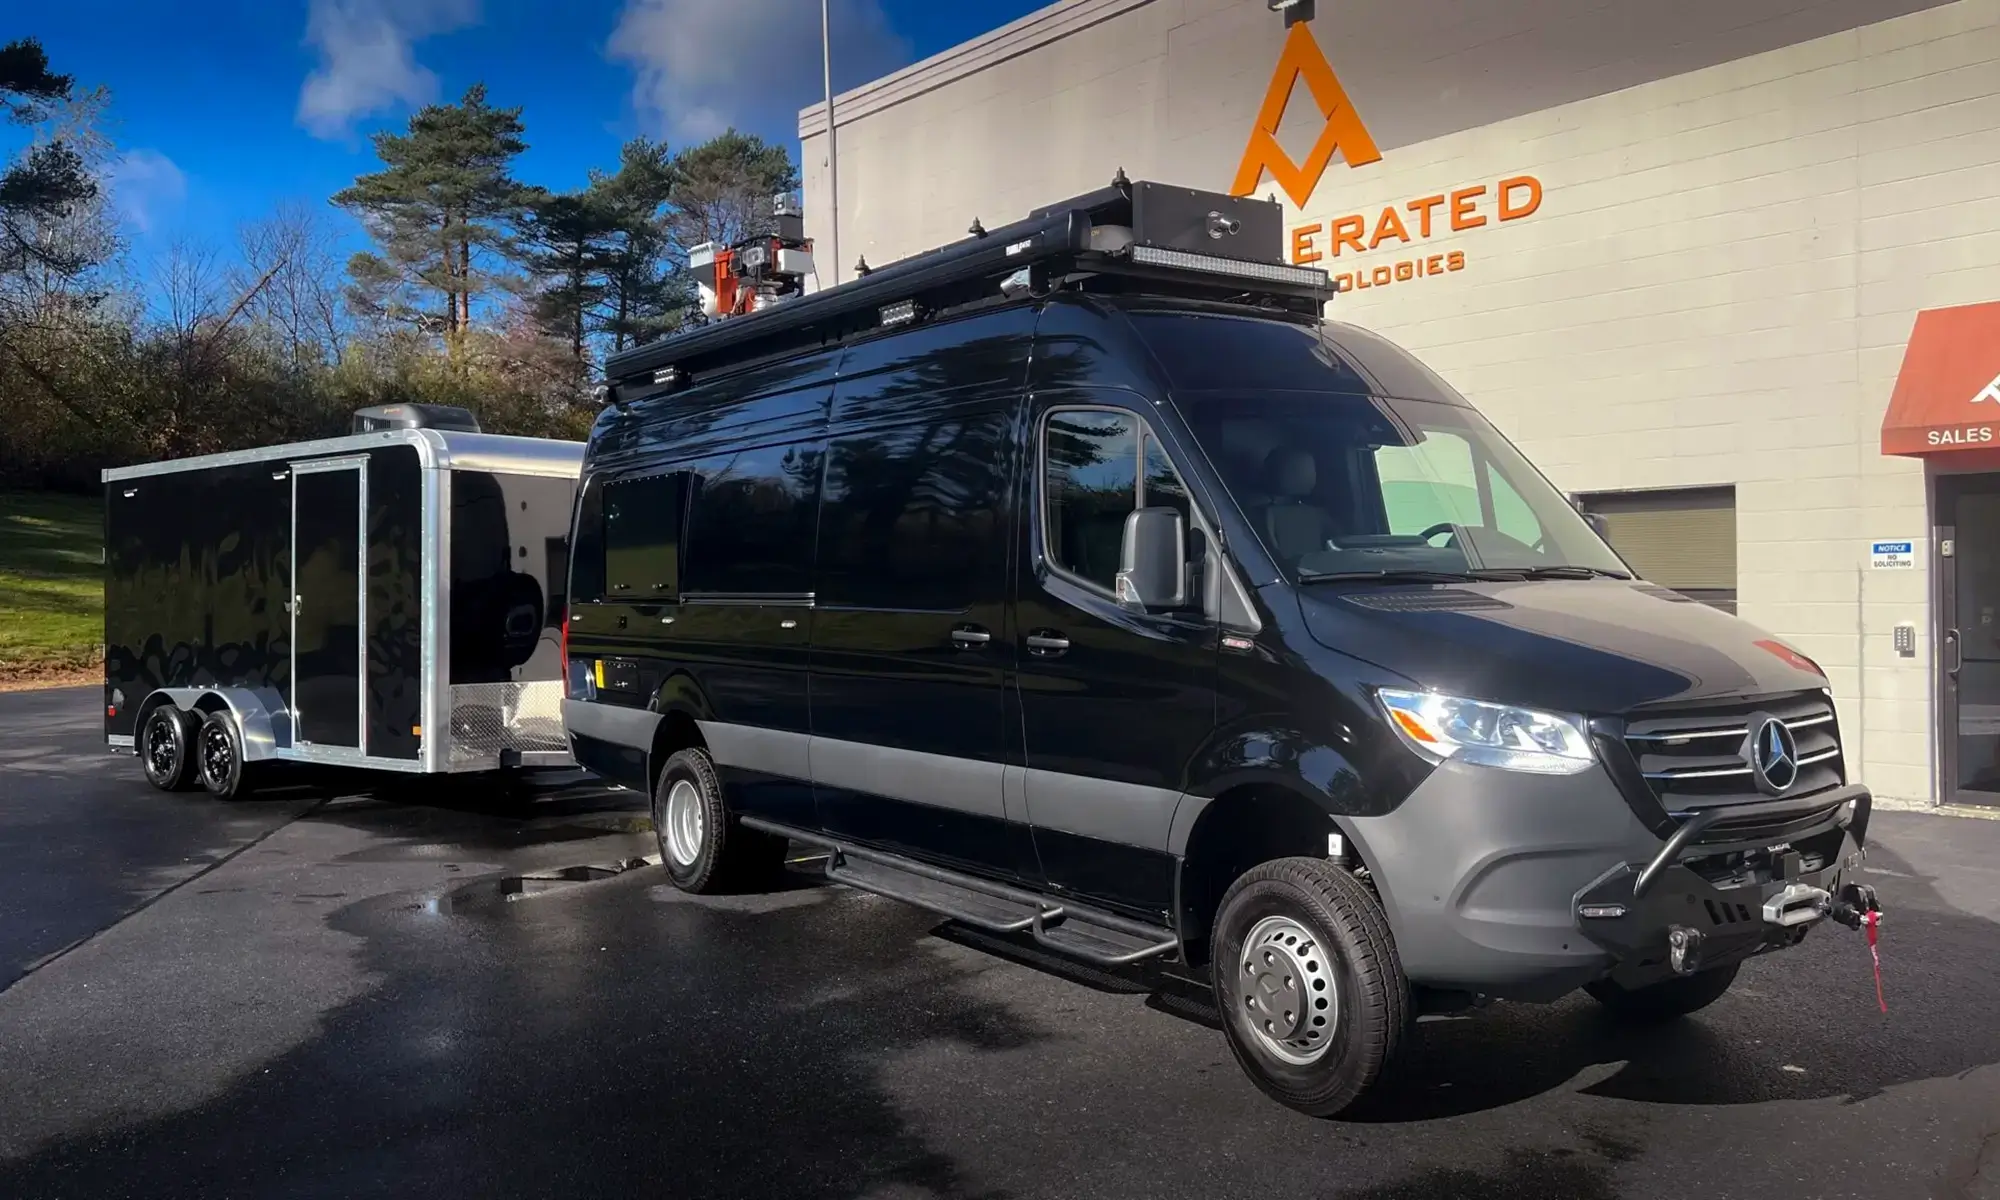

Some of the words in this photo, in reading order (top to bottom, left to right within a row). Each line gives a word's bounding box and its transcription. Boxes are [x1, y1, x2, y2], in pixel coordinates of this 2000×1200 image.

[1927, 426, 1993, 446] SALES
[1877, 544, 1907, 552] NOTICE
[1873, 560, 1912, 568] SOLICITING
